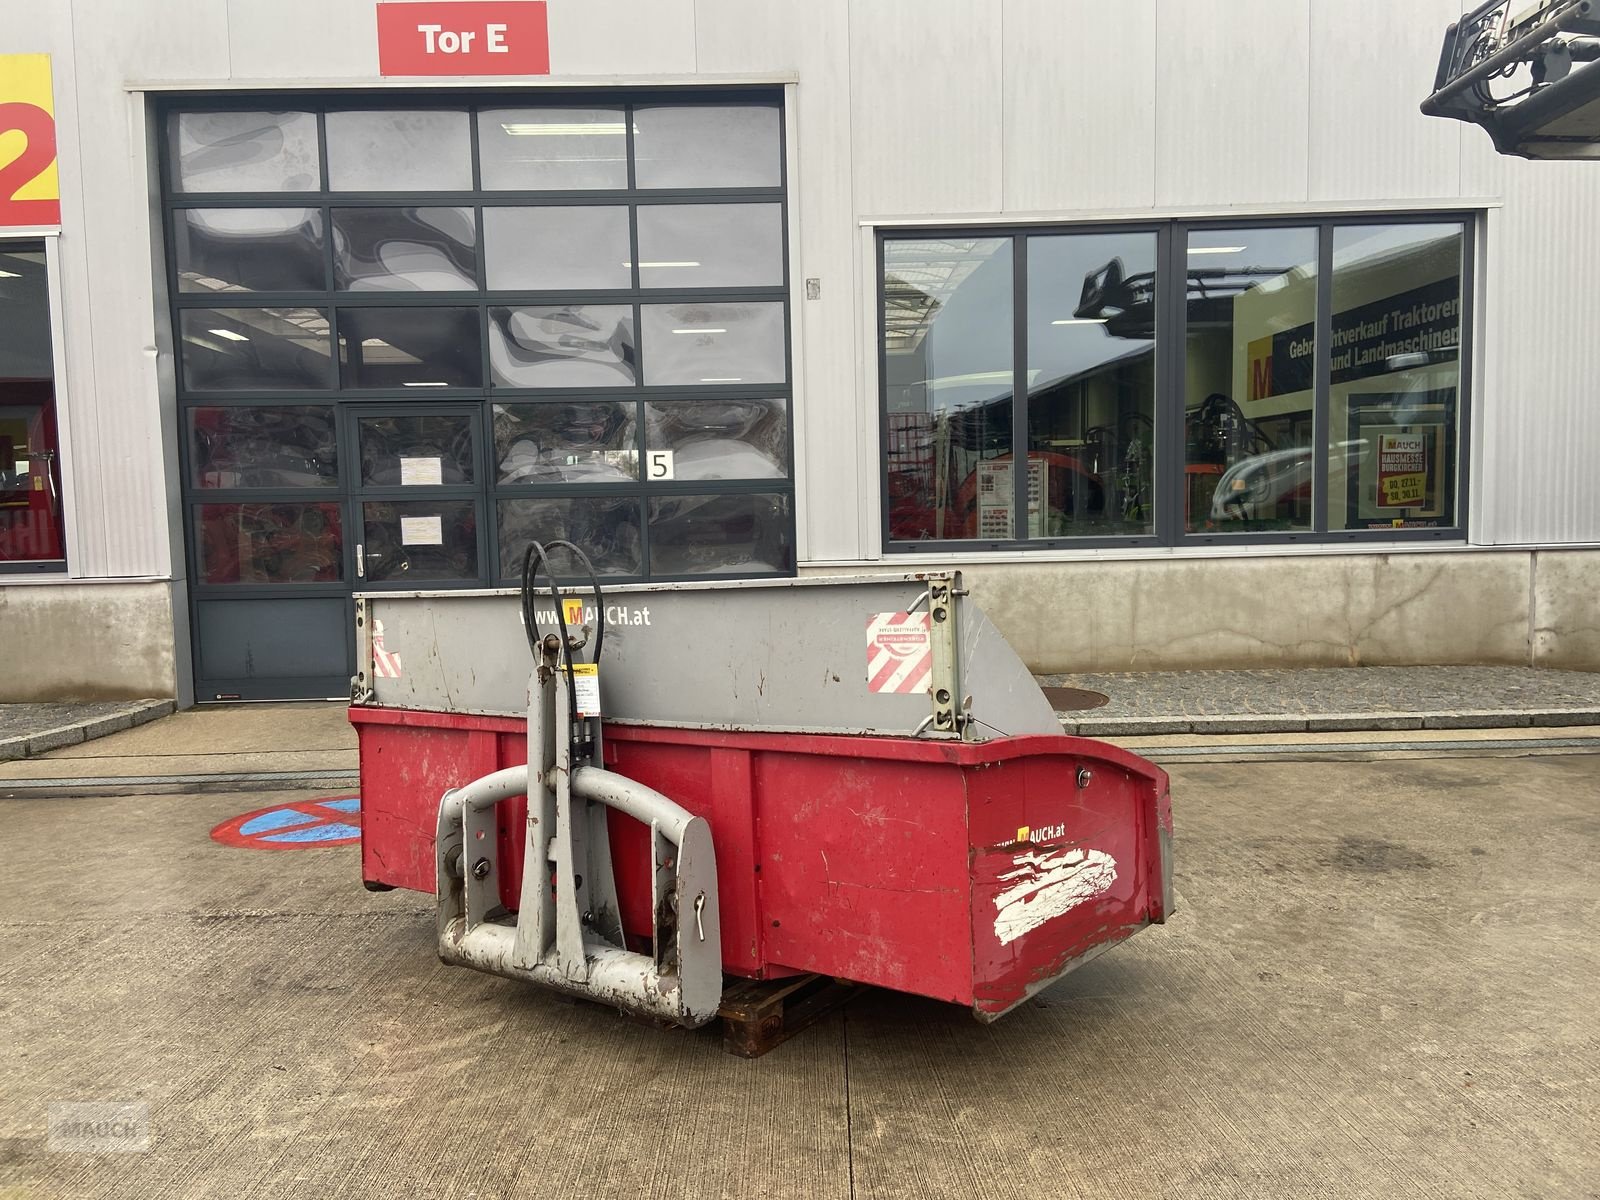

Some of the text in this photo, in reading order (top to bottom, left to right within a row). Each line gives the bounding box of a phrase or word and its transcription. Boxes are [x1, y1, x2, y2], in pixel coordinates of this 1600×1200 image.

[417, 23, 509, 54] Tor E
[1391, 299, 1460, 332] Traktoren
[1330, 325, 1460, 372] und Landmaschinen
[1387, 441, 1421, 450] MAUCH
[652, 454, 667, 478] 5
[1381, 453, 1424, 463] HAUSMESSE
[519, 606, 651, 626] wwMACH.at
